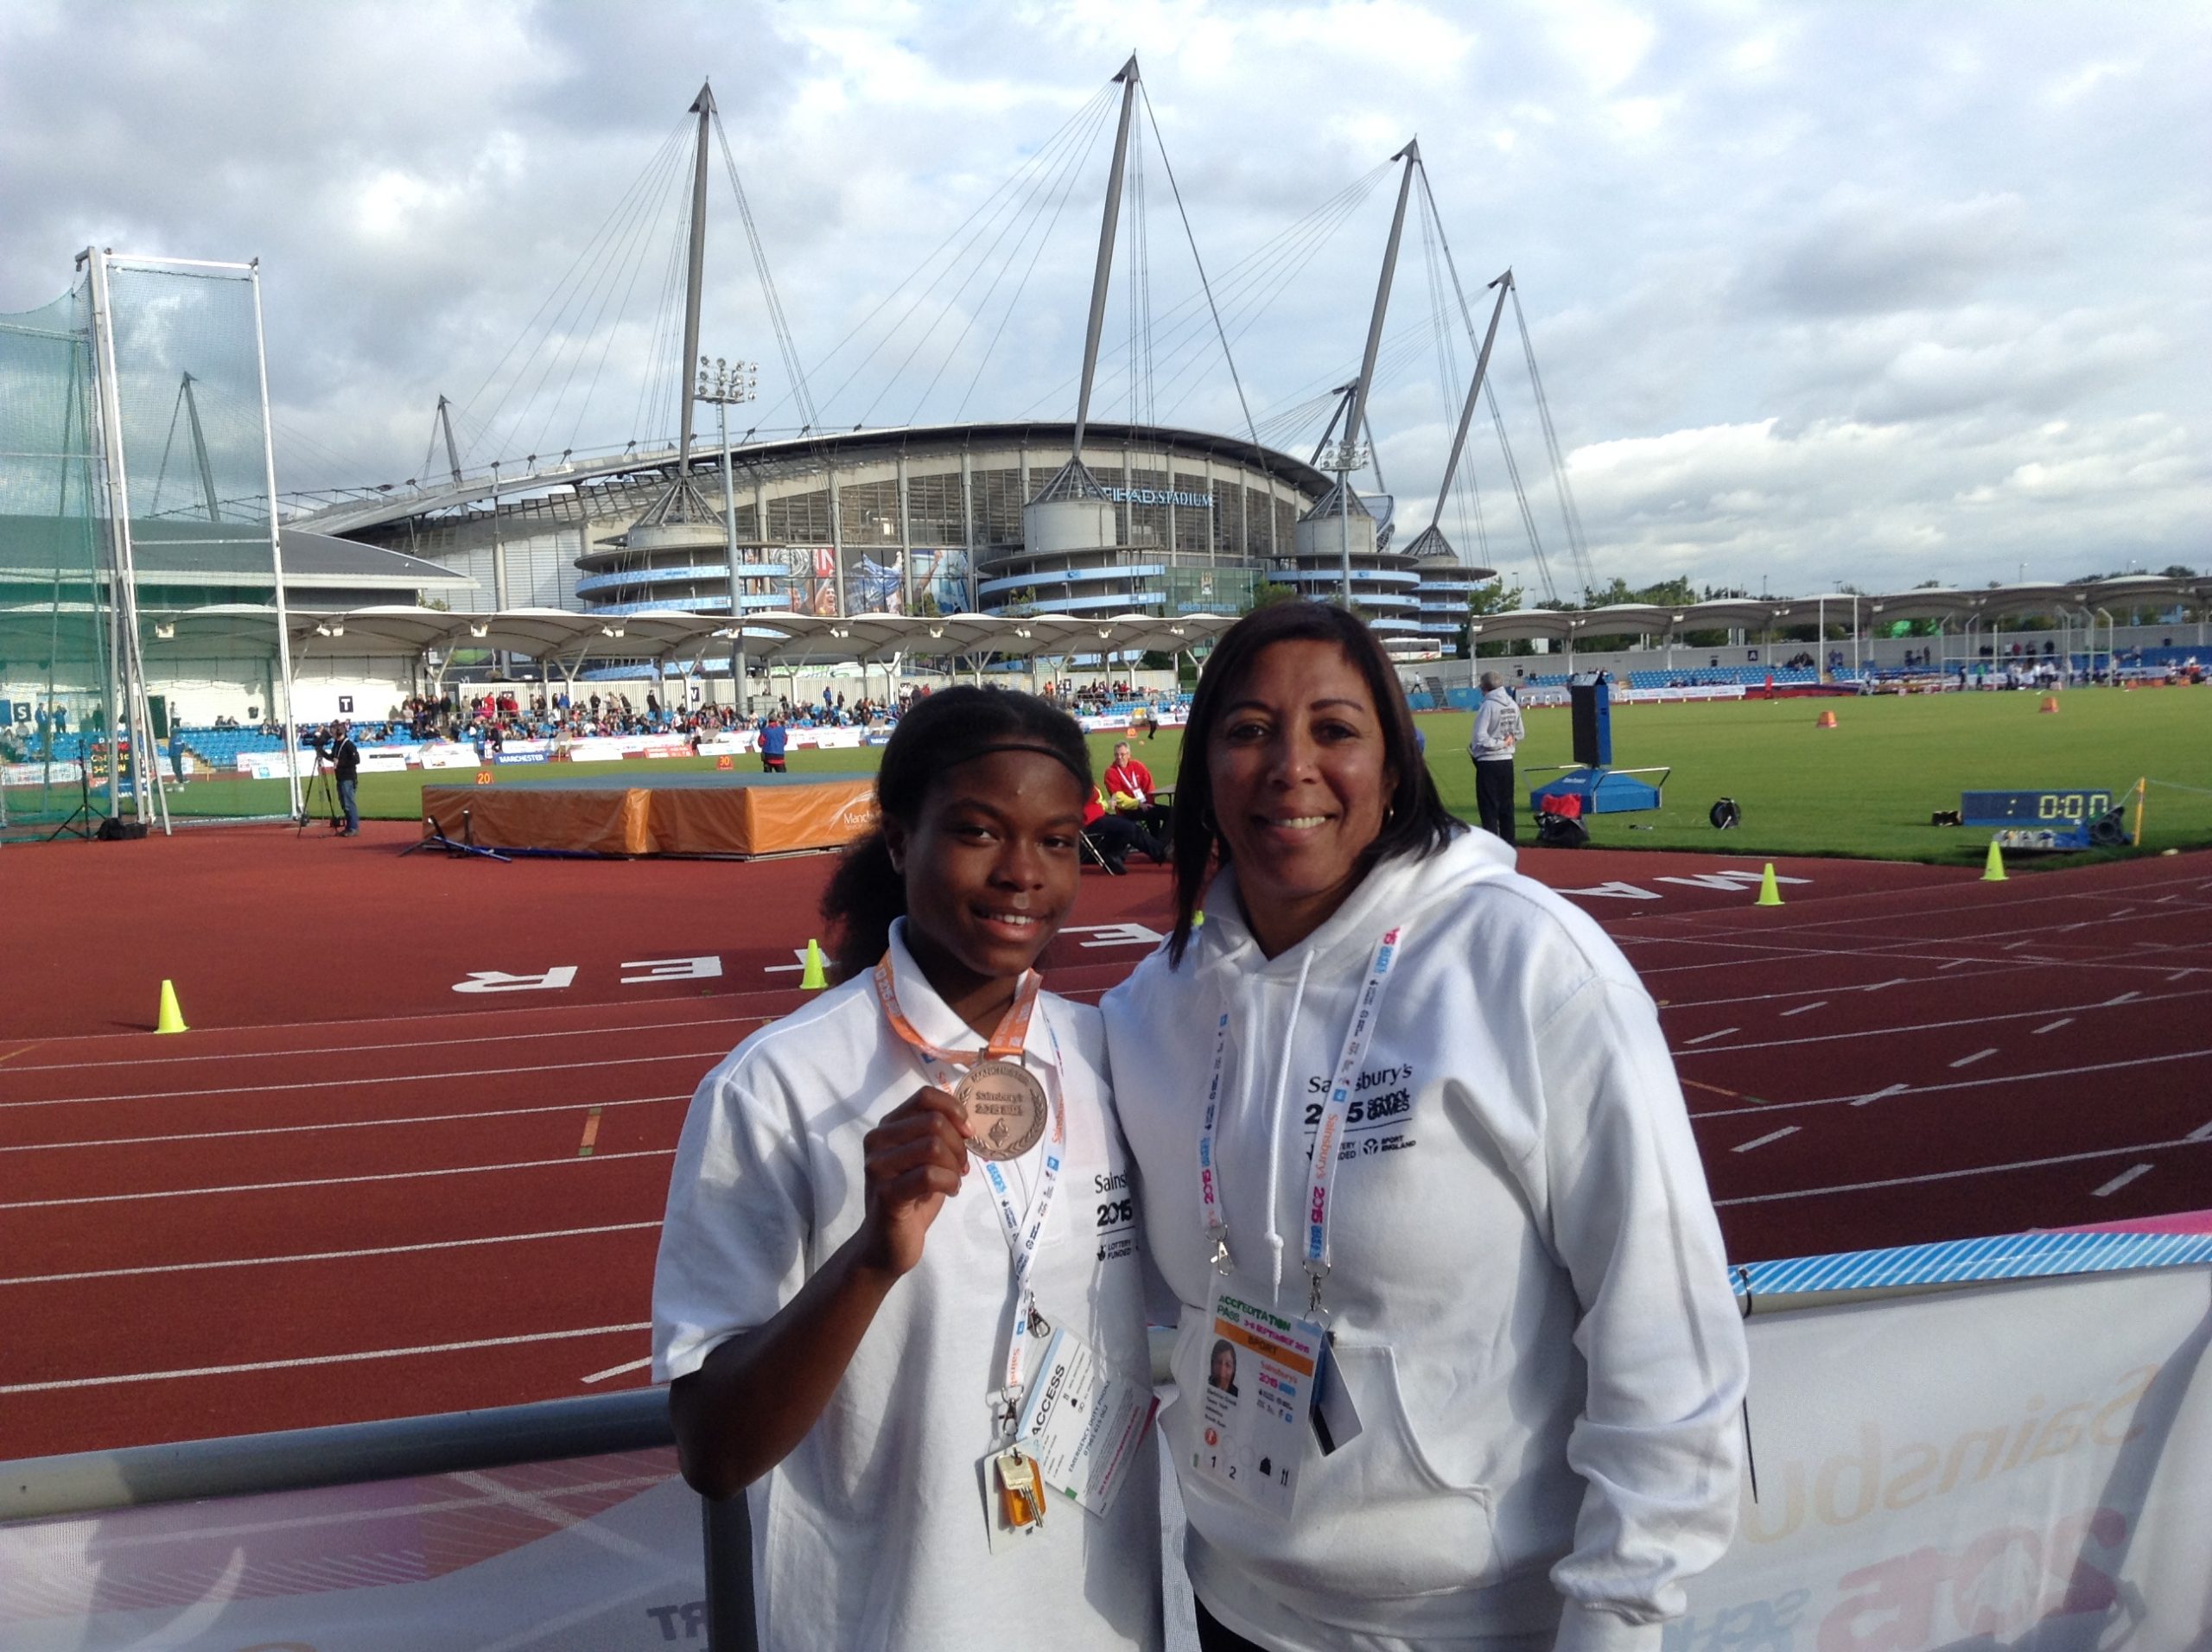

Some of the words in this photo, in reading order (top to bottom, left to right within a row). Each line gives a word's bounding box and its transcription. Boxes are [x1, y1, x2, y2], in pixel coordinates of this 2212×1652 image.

[1158, 490, 1215, 508] STADIUM
[17, 705, 28, 720] S
[341, 697, 350, 711] T
[499, 753, 544, 763] MANCHESTER
[719, 756, 730, 766] 30
[477, 772, 490, 784] 20
[1307, 1063, 1413, 1094] Sasbury's
[1304, 1101, 1364, 1125] 25
[1367, 1088, 1410, 1107] SCHOOL
[1367, 1100, 1410, 1121] GAMES
[1315, 1113, 1339, 1180] Sainsbury's
[1381, 1135, 1404, 1145] SPORT
[1381, 1141, 1416, 1152] ENGLAND
[1202, 1168, 1214, 1204] 2015
[1096, 1198, 1133, 1227] 2015
[1310, 1186, 1325, 1224] 2015
[1108, 1248, 1132, 1260] FUNDED
[1217, 1305, 1240, 1323] PASS
[1247, 1335, 1278, 1354] SPORT
[1031, 1363, 1065, 1436] ACCESS
[1067, 1426, 1091, 1473] EMERGENCY
[1087, 1406, 1100, 1426] DUTY
[1211, 1455, 1217, 1468] 1
[1229, 1465, 1236, 1479] 2
